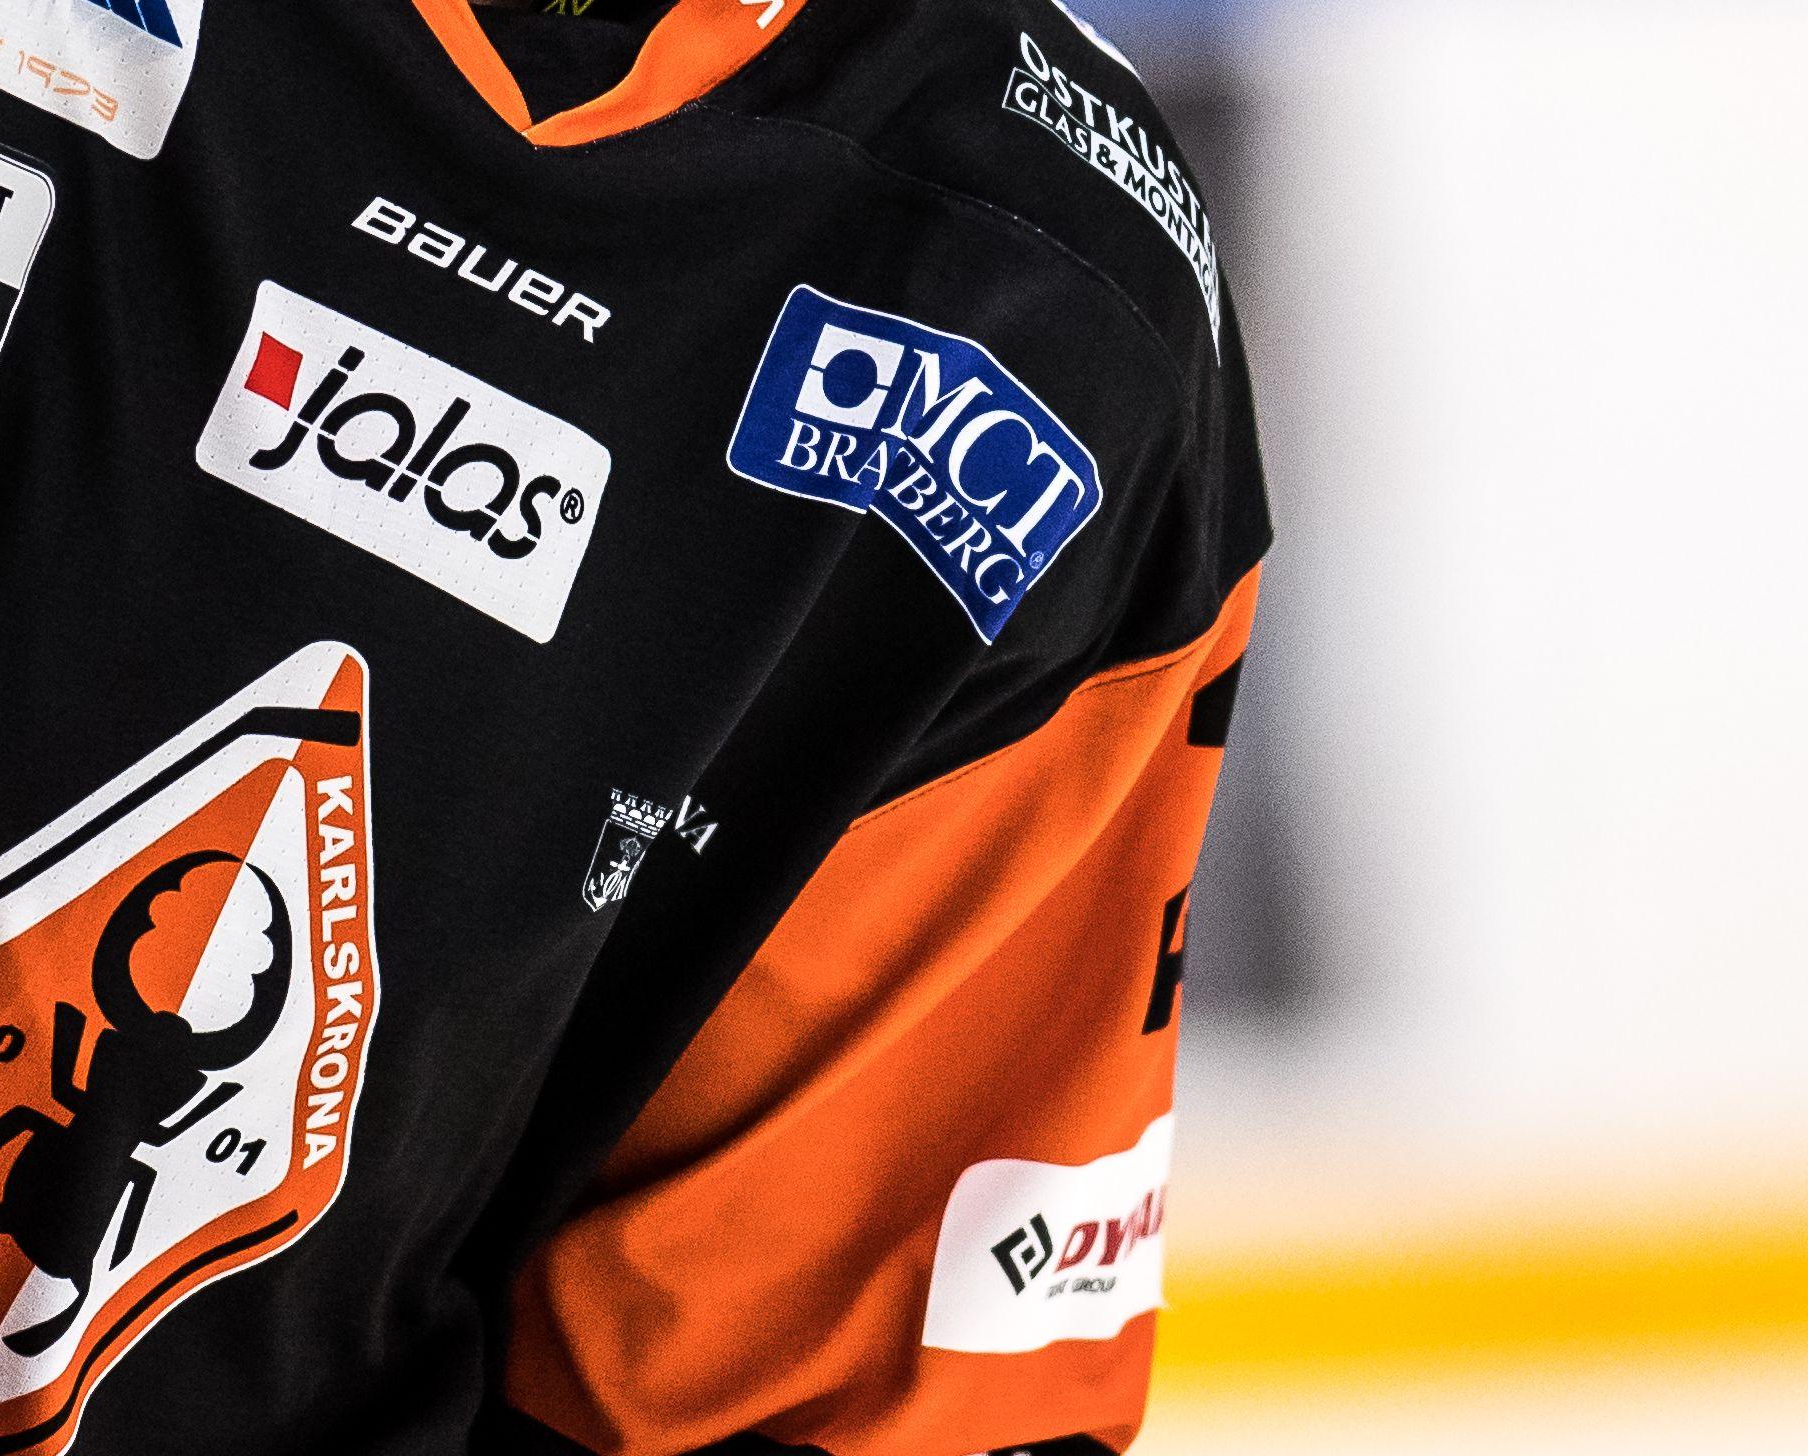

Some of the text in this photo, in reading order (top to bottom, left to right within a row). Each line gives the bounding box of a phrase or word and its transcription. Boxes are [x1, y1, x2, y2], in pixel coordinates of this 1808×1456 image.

[1015, 82, 1088, 154] GLAS
[1095, 146, 1118, 175] &
[350, 195, 611, 343] BAUER
[881, 348, 1085, 558] MCT
[302, 775, 364, 1171] KARLSKRONA
[205, 1127, 267, 1176] 01
